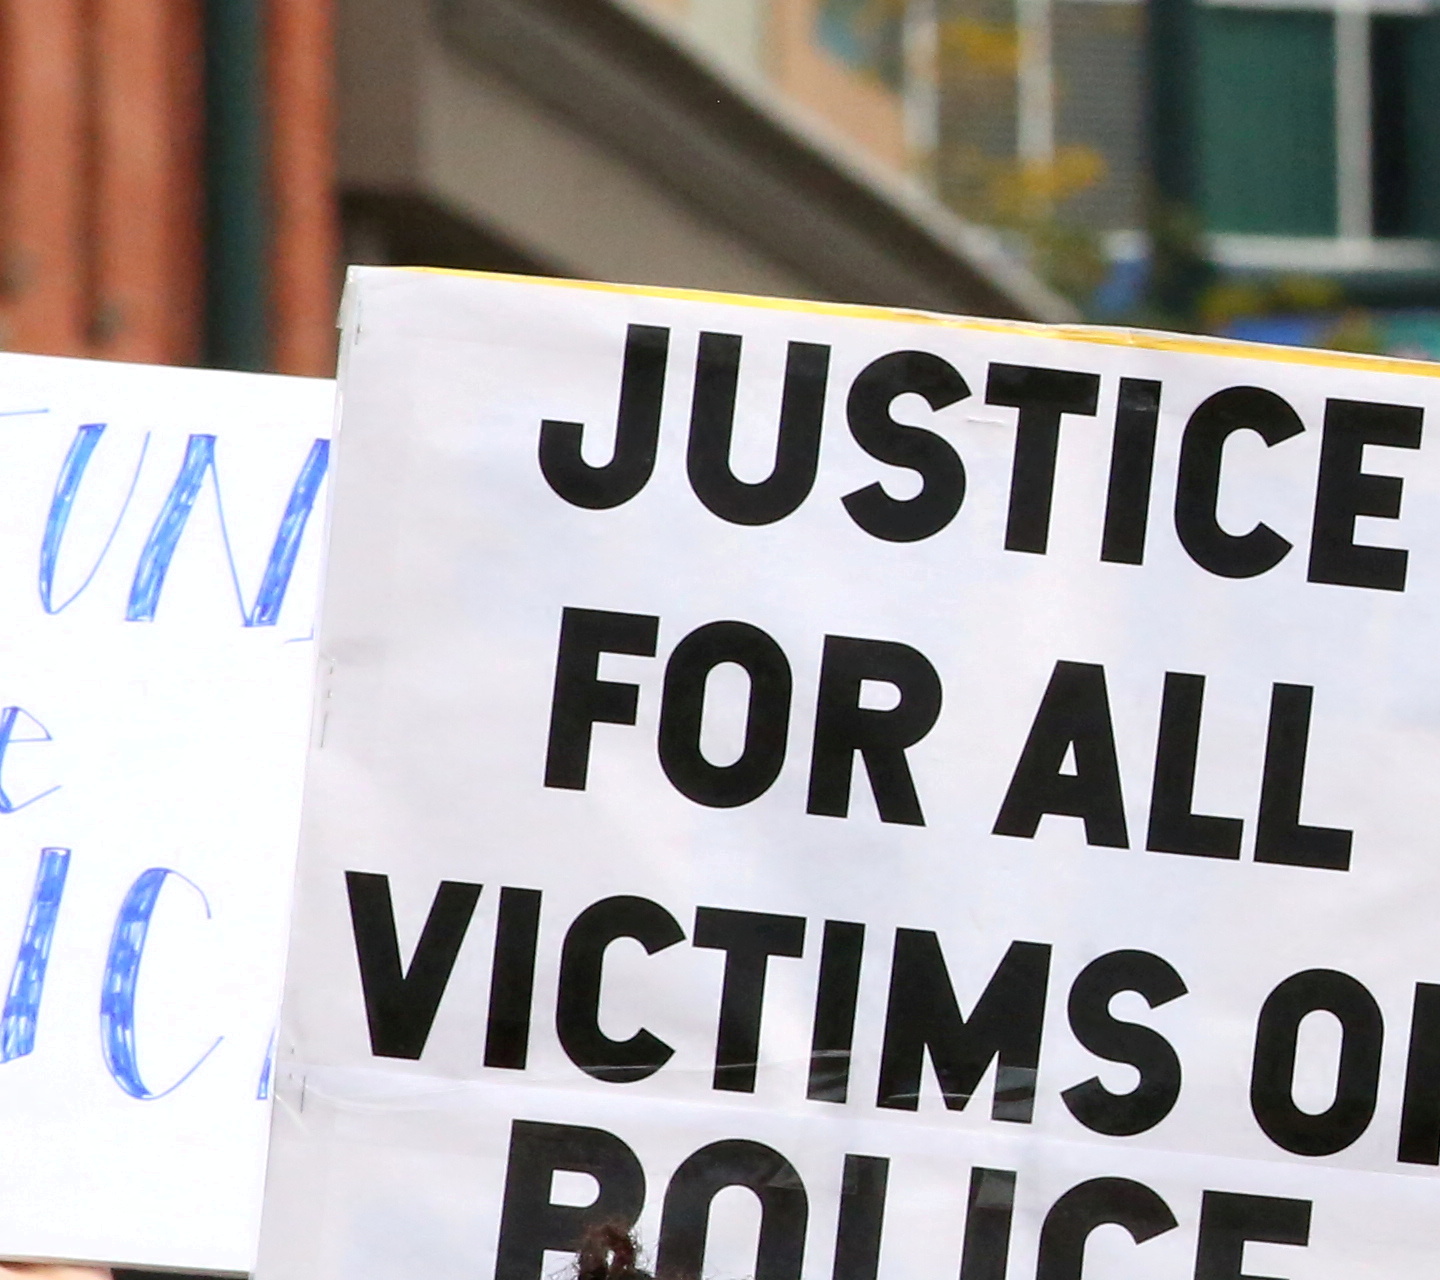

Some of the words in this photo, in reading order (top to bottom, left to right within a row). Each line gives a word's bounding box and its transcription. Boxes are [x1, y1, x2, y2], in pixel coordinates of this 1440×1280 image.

[538, 323, 1424, 593] JUSTICE
[543, 606, 943, 827] FOR
[992, 659, 1353, 871] ALL
[344, 870, 1188, 1137] VICTIMS
